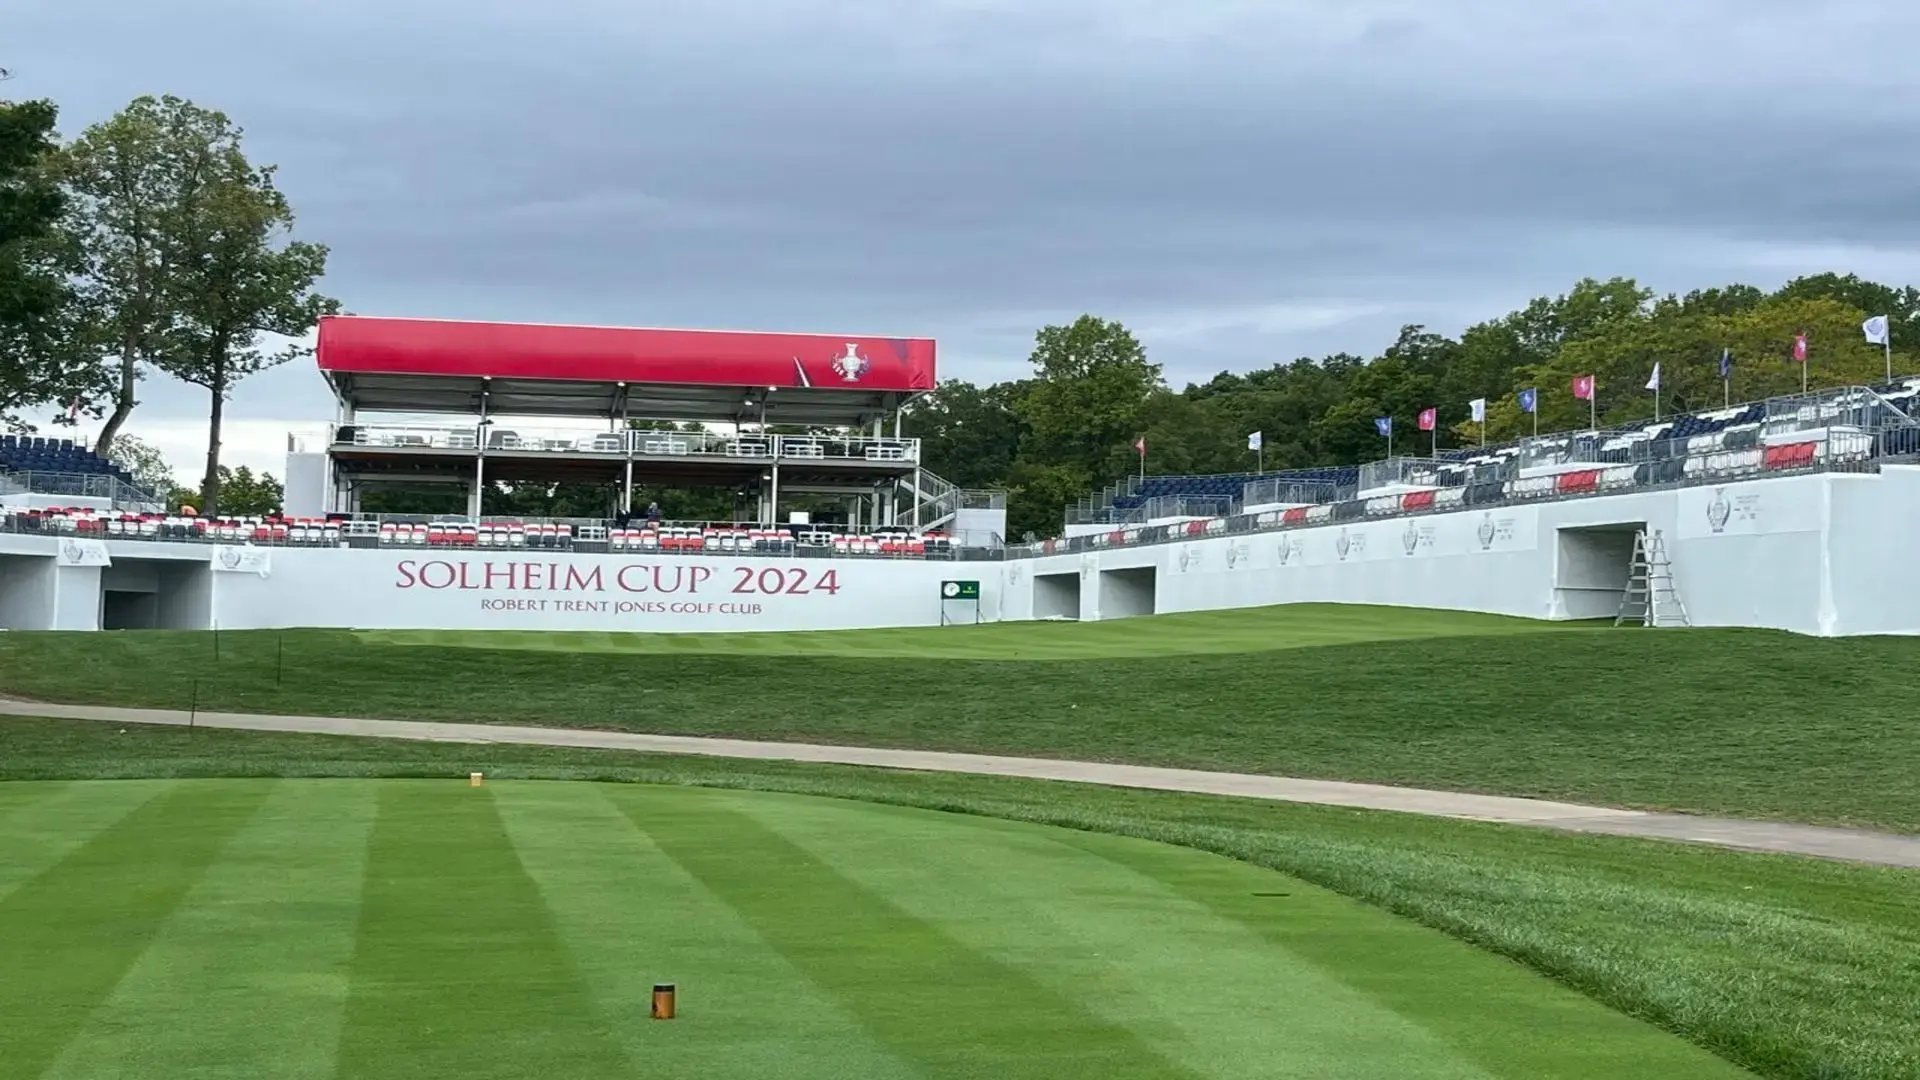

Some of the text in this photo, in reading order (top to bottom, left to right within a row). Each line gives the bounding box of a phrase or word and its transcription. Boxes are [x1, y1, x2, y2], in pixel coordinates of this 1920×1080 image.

[395, 559, 842, 596] SOLHEIM CUP 2024
[480, 598, 763, 616] ROBERT TRENT JONES GOLF CLUB
